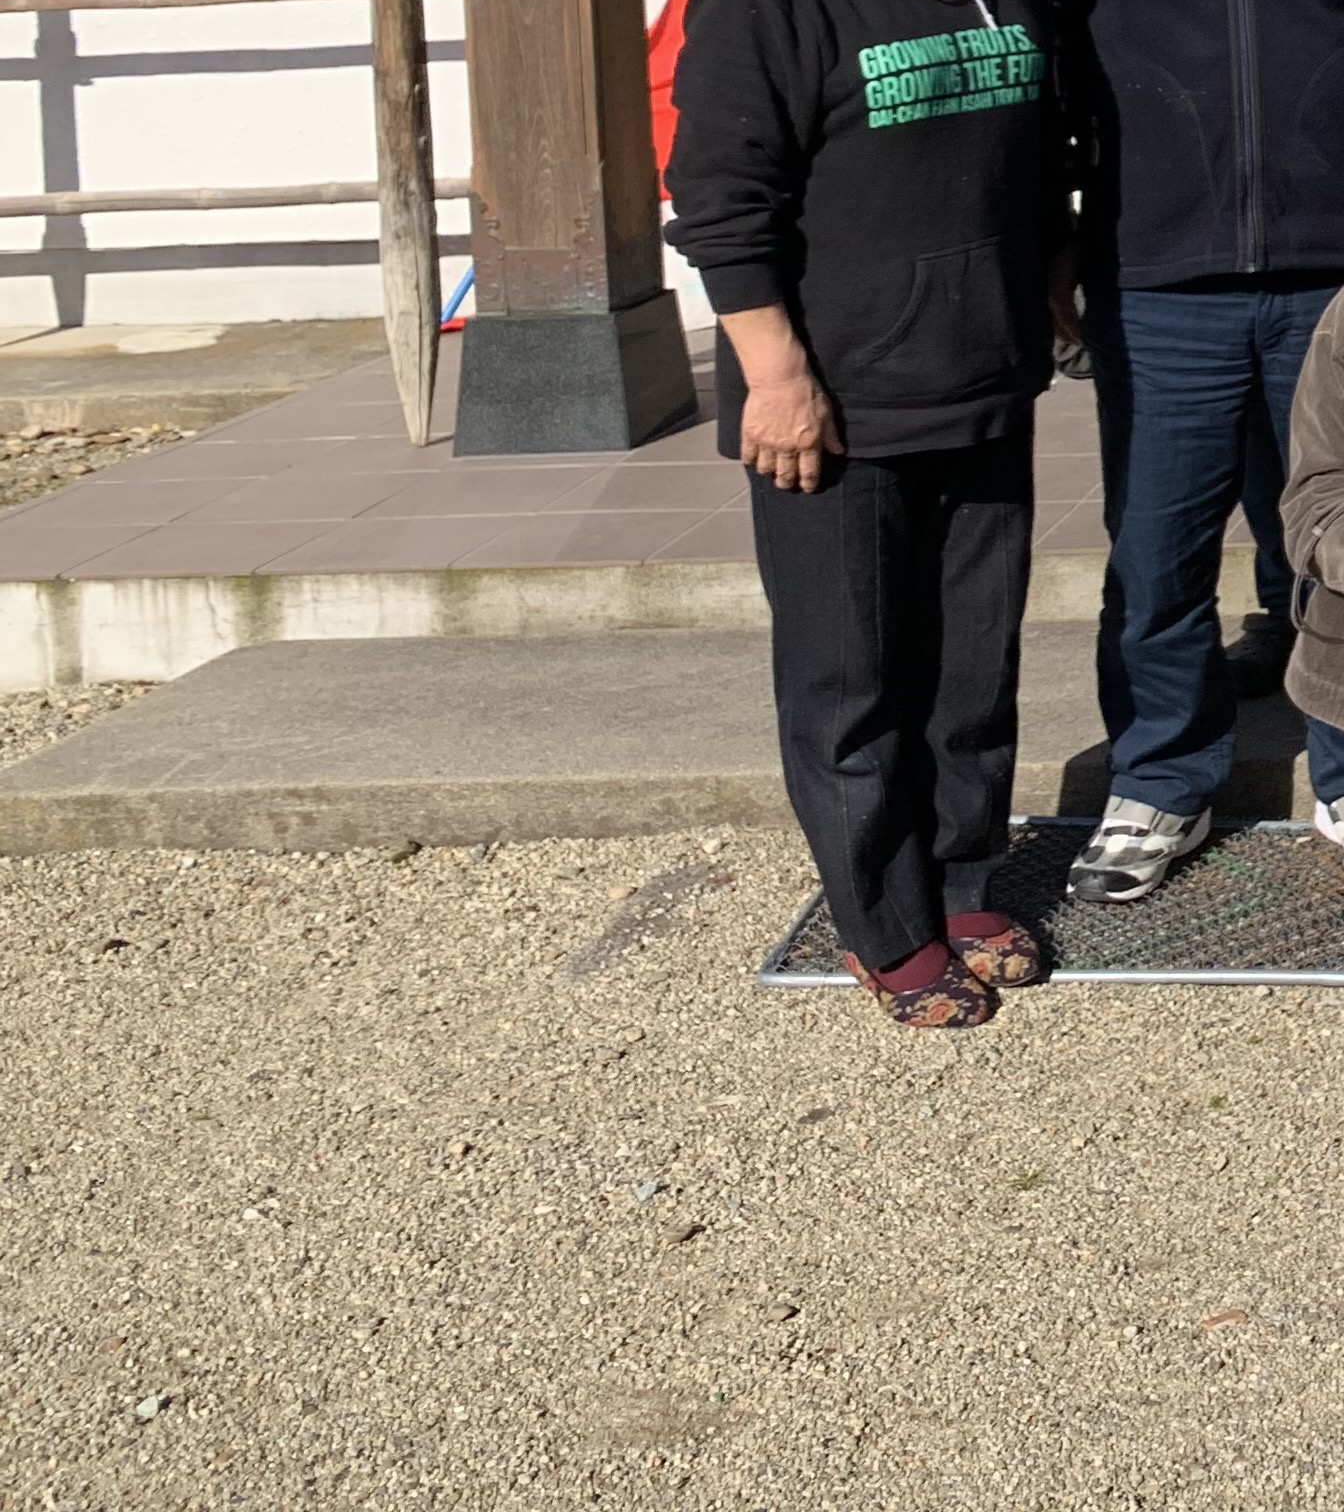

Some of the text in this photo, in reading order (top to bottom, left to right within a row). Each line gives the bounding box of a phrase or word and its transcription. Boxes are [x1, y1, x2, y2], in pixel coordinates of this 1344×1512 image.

[859, 34, 957, 79] GROWING
[865, 64, 961, 109] GROWING
[962, 57, 1004, 92] THE
